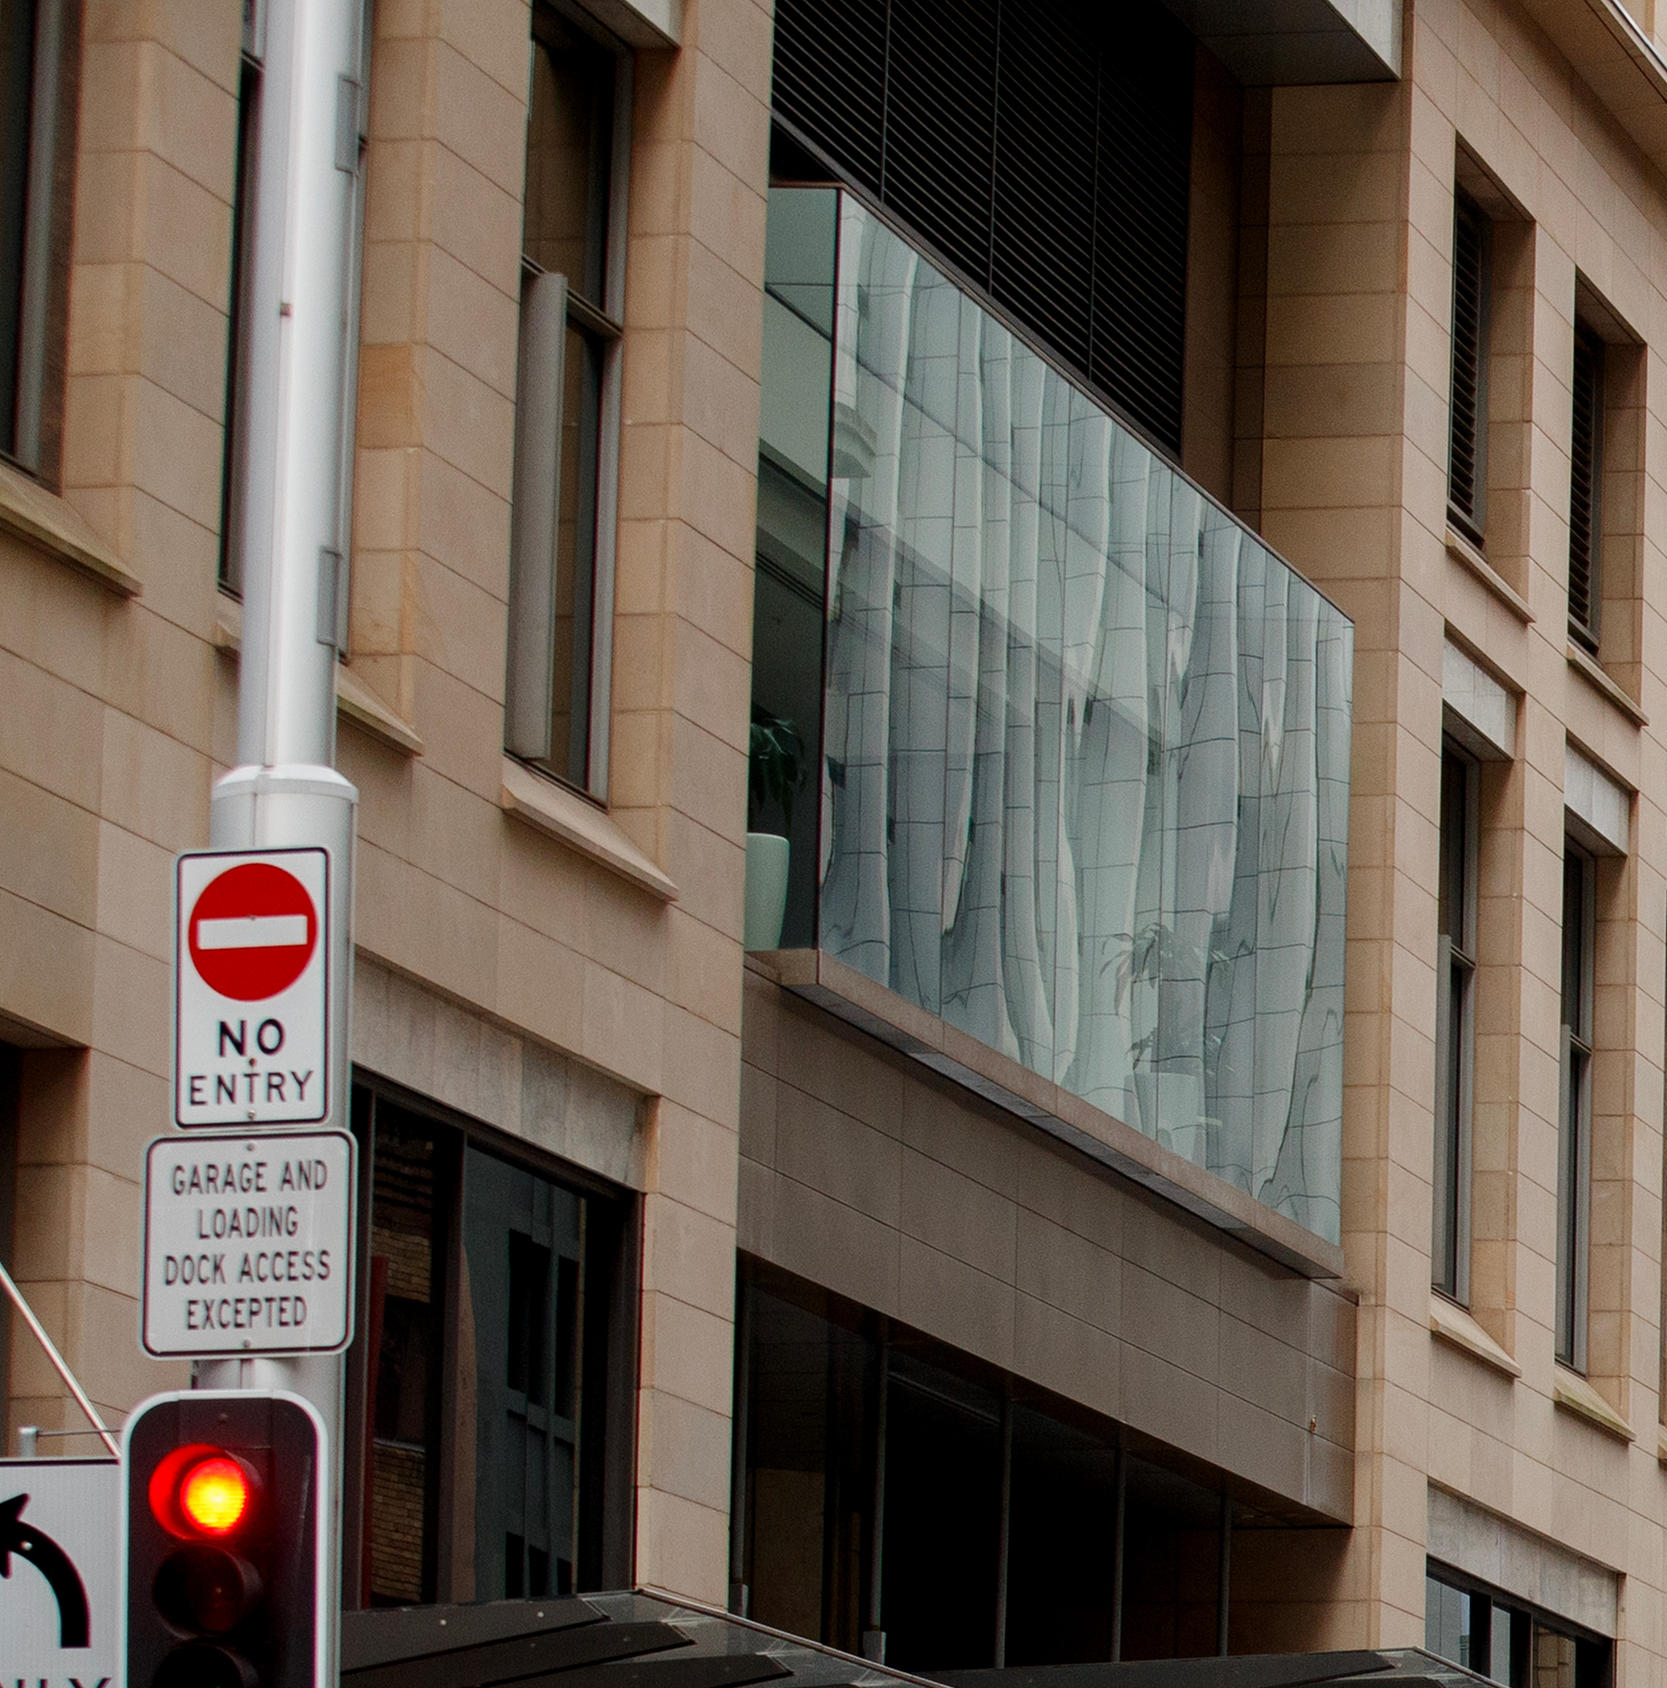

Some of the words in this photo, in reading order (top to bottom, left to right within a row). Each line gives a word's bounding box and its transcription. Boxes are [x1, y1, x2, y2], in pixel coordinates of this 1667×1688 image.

[218, 1018, 286, 1057] NO
[189, 1070, 314, 1106] ENTRY
[172, 1162, 268, 1196] GARAGE
[280, 1159, 328, 1191] AND
[198, 1206, 299, 1240] LOADING
[164, 1254, 226, 1286] DOCK
[238, 1250, 331, 1284] ACCESS
[187, 1296, 307, 1330] EXCEPTED
